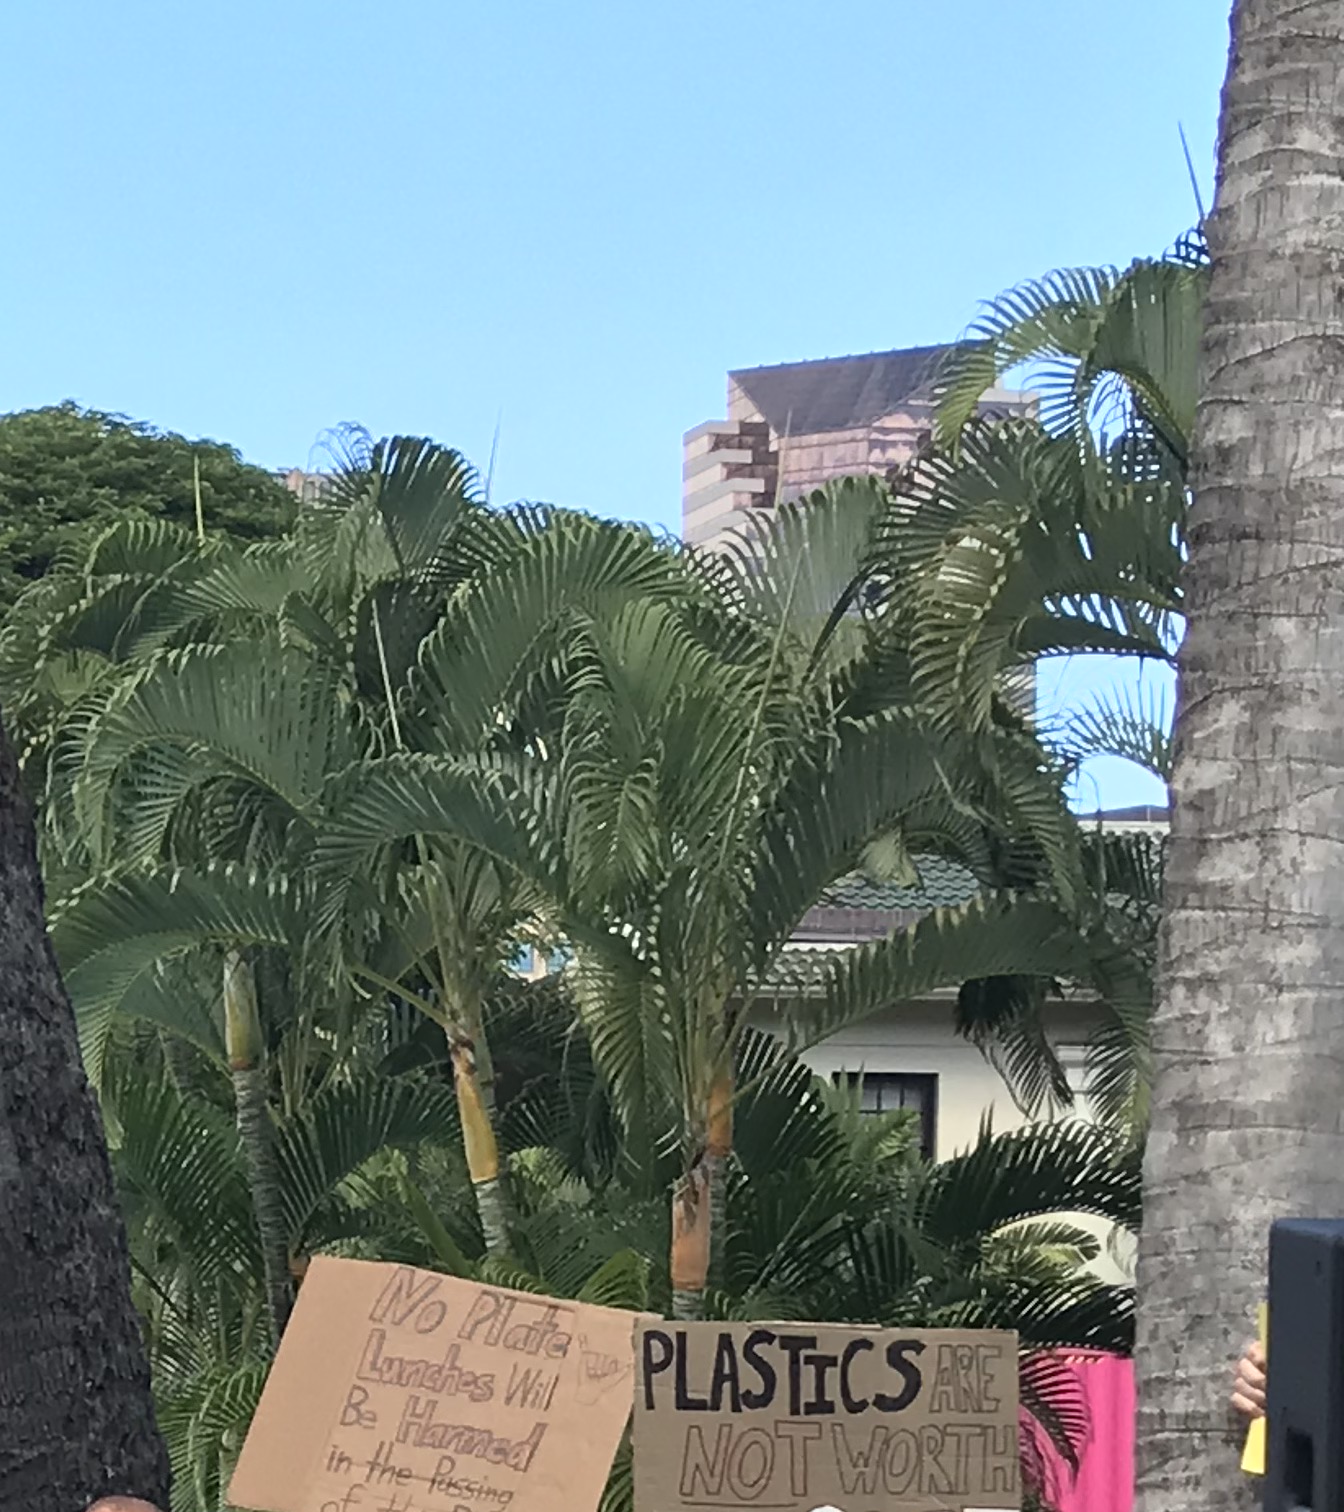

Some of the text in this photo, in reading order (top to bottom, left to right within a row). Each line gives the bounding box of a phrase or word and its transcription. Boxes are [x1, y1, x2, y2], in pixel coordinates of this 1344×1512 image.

[369, 1267, 575, 1359] No Plate
[356, 1329, 559, 1411] Lunches Will
[643, 1329, 1002, 1416] PLASTICS ARE
[325, 1444, 353, 1474] in
[366, 1442, 412, 1487] the
[340, 1384, 547, 1472] Be Harmed
[680, 1420, 1015, 1499] NOT WORTH
